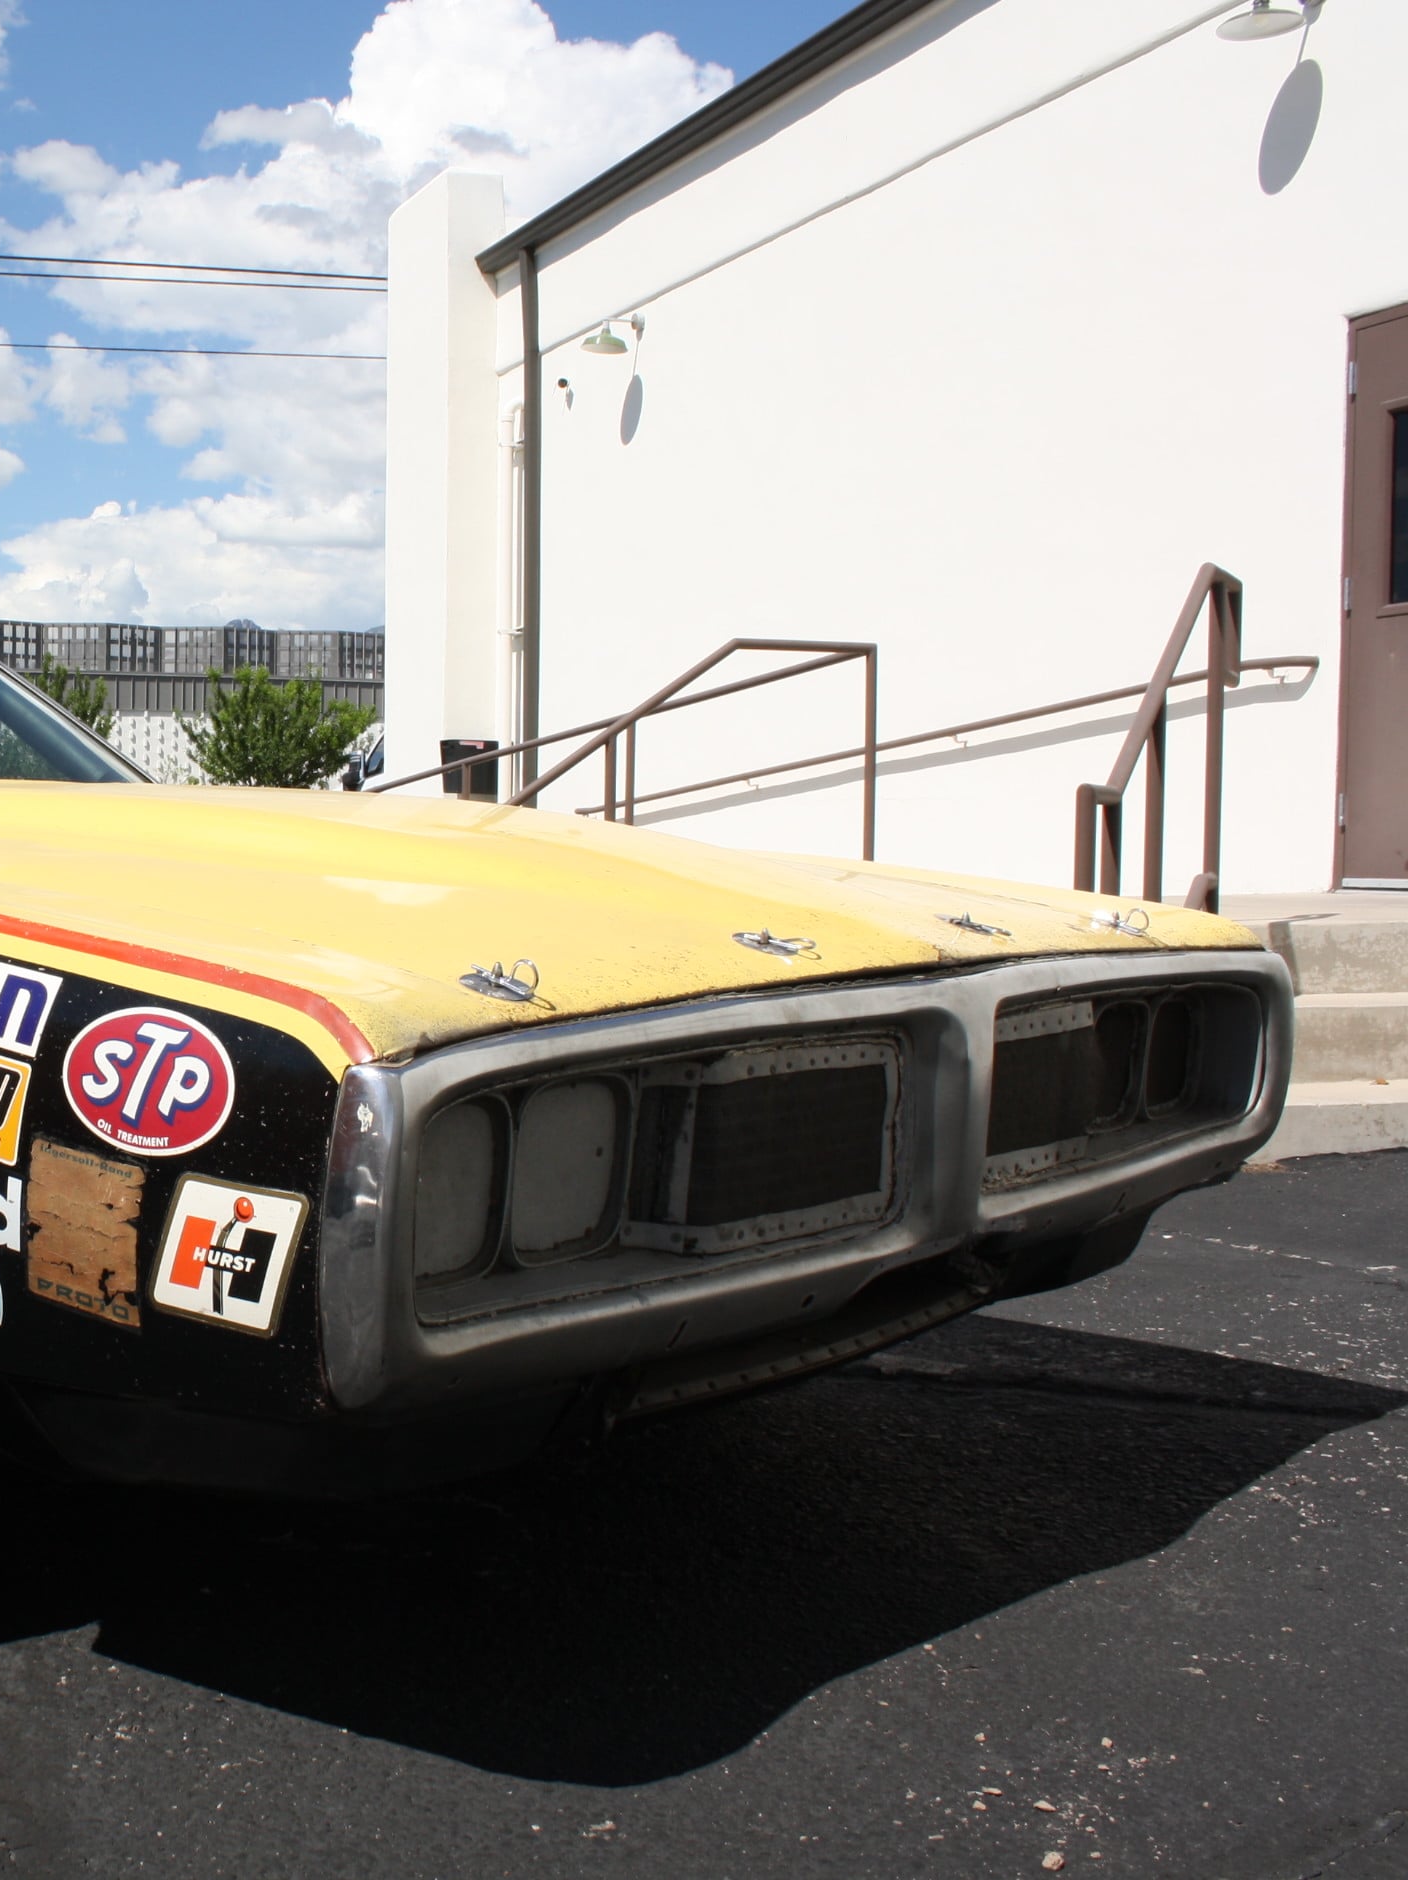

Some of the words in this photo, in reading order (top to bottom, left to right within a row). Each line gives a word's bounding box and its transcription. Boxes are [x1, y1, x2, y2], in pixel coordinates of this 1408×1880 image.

[81, 1022, 211, 1127] STP
[97, 1118, 112, 1135] OIL
[117, 1127, 169, 1148] TREATMENT
[192, 1246, 256, 1273] HURST
[37, 1277, 129, 1320] PROTO
